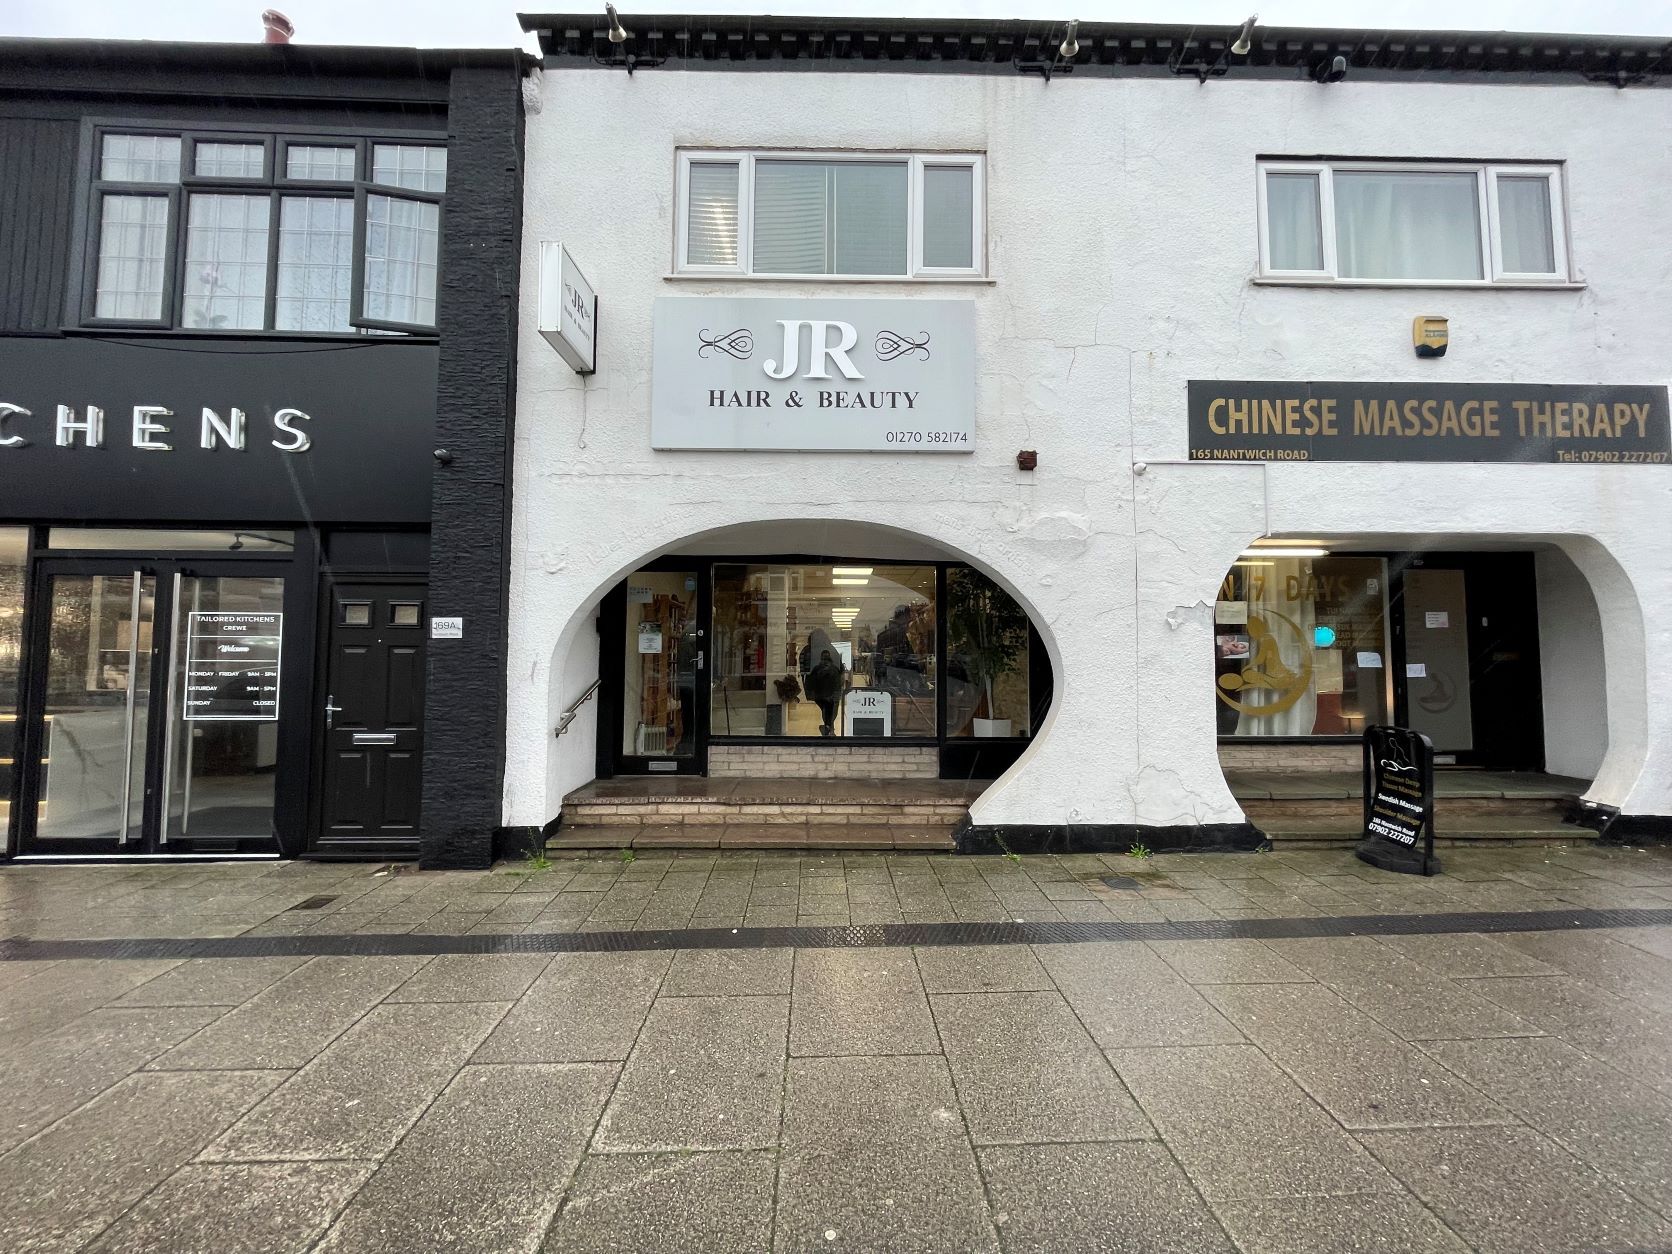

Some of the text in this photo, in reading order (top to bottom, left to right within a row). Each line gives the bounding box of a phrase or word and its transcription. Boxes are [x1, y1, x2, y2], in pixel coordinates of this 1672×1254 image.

[763, 319, 865, 380] JR
[707, 389, 920, 409] HAIR & BEAUTY
[1208, 398, 1650, 438] CHINESE MASSAGE THERAPY
[886, 431, 968, 443] 01270 582174
[1191, 448, 1309, 460] 165 NANTWICH ROAD
[1557, 450, 1668, 463] Tel: 07902 227207
[1253, 576, 1265, 601] 7
[1285, 575, 1351, 602] DAYS
[433, 621, 456, 630] 169A
[861, 697, 876, 707] JR
[1399, 799, 1423, 813] Massage
[1368, 822, 1415, 845] 07902 227207
